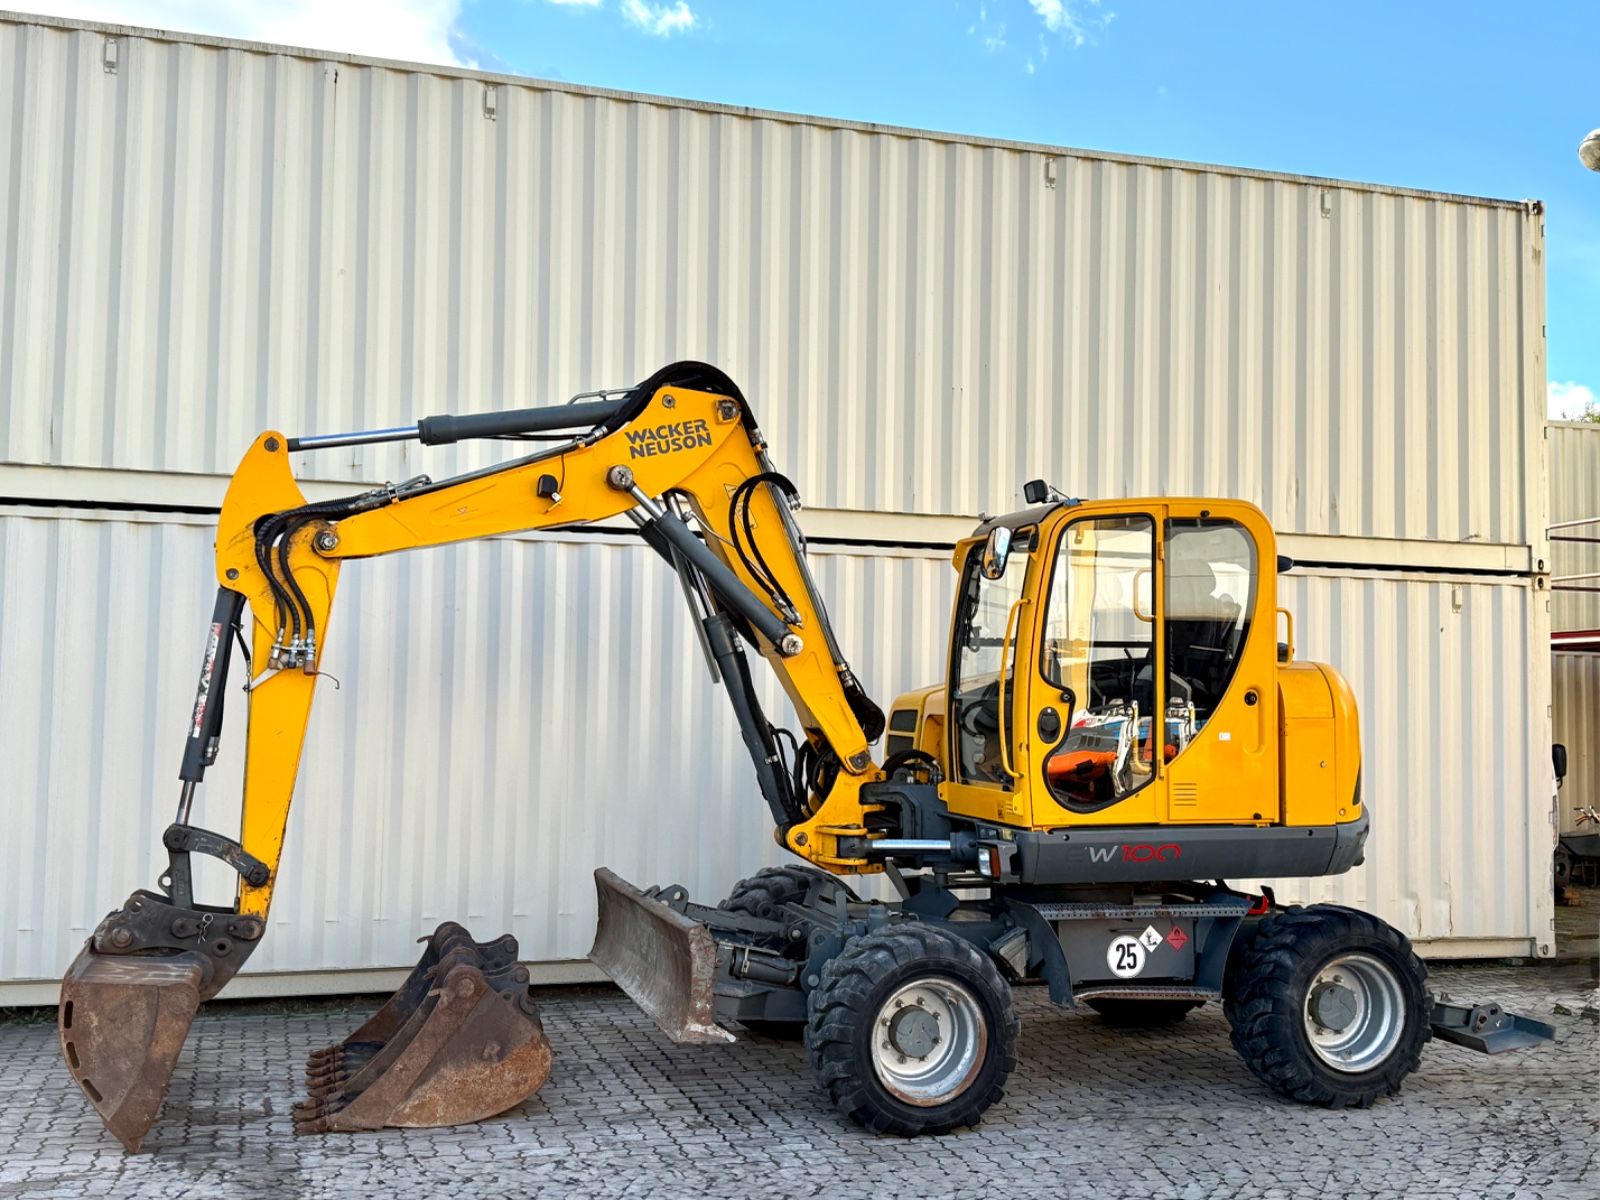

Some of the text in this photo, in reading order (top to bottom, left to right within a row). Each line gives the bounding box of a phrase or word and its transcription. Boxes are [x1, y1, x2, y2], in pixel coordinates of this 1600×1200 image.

[625, 419, 709, 445] WACKER
[629, 433, 713, 459] NEUSON
[1116, 943, 1137, 970] 25
